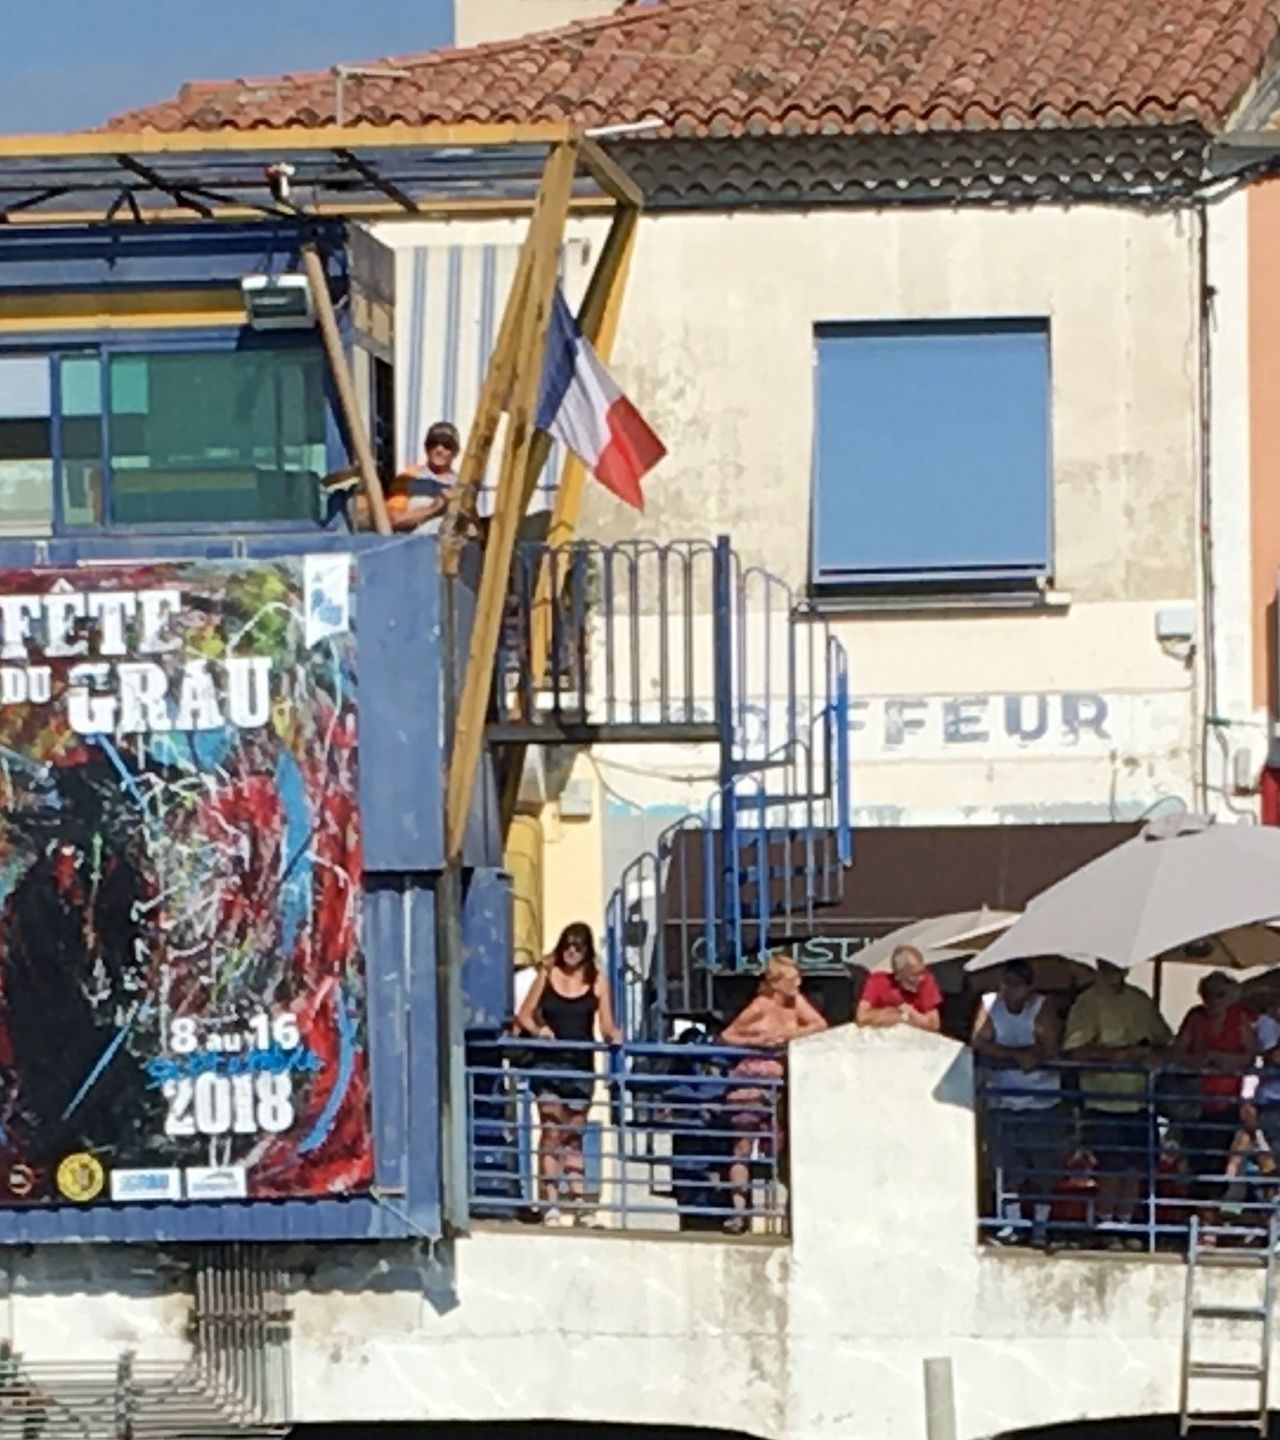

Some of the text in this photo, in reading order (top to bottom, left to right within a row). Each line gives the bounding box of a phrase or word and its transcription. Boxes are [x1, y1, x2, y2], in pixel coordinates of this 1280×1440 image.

[0, 656, 274, 735] DU GRAU
[171, 1013, 300, 1052] 8 au 16
[163, 1071, 294, 1135] 2018
